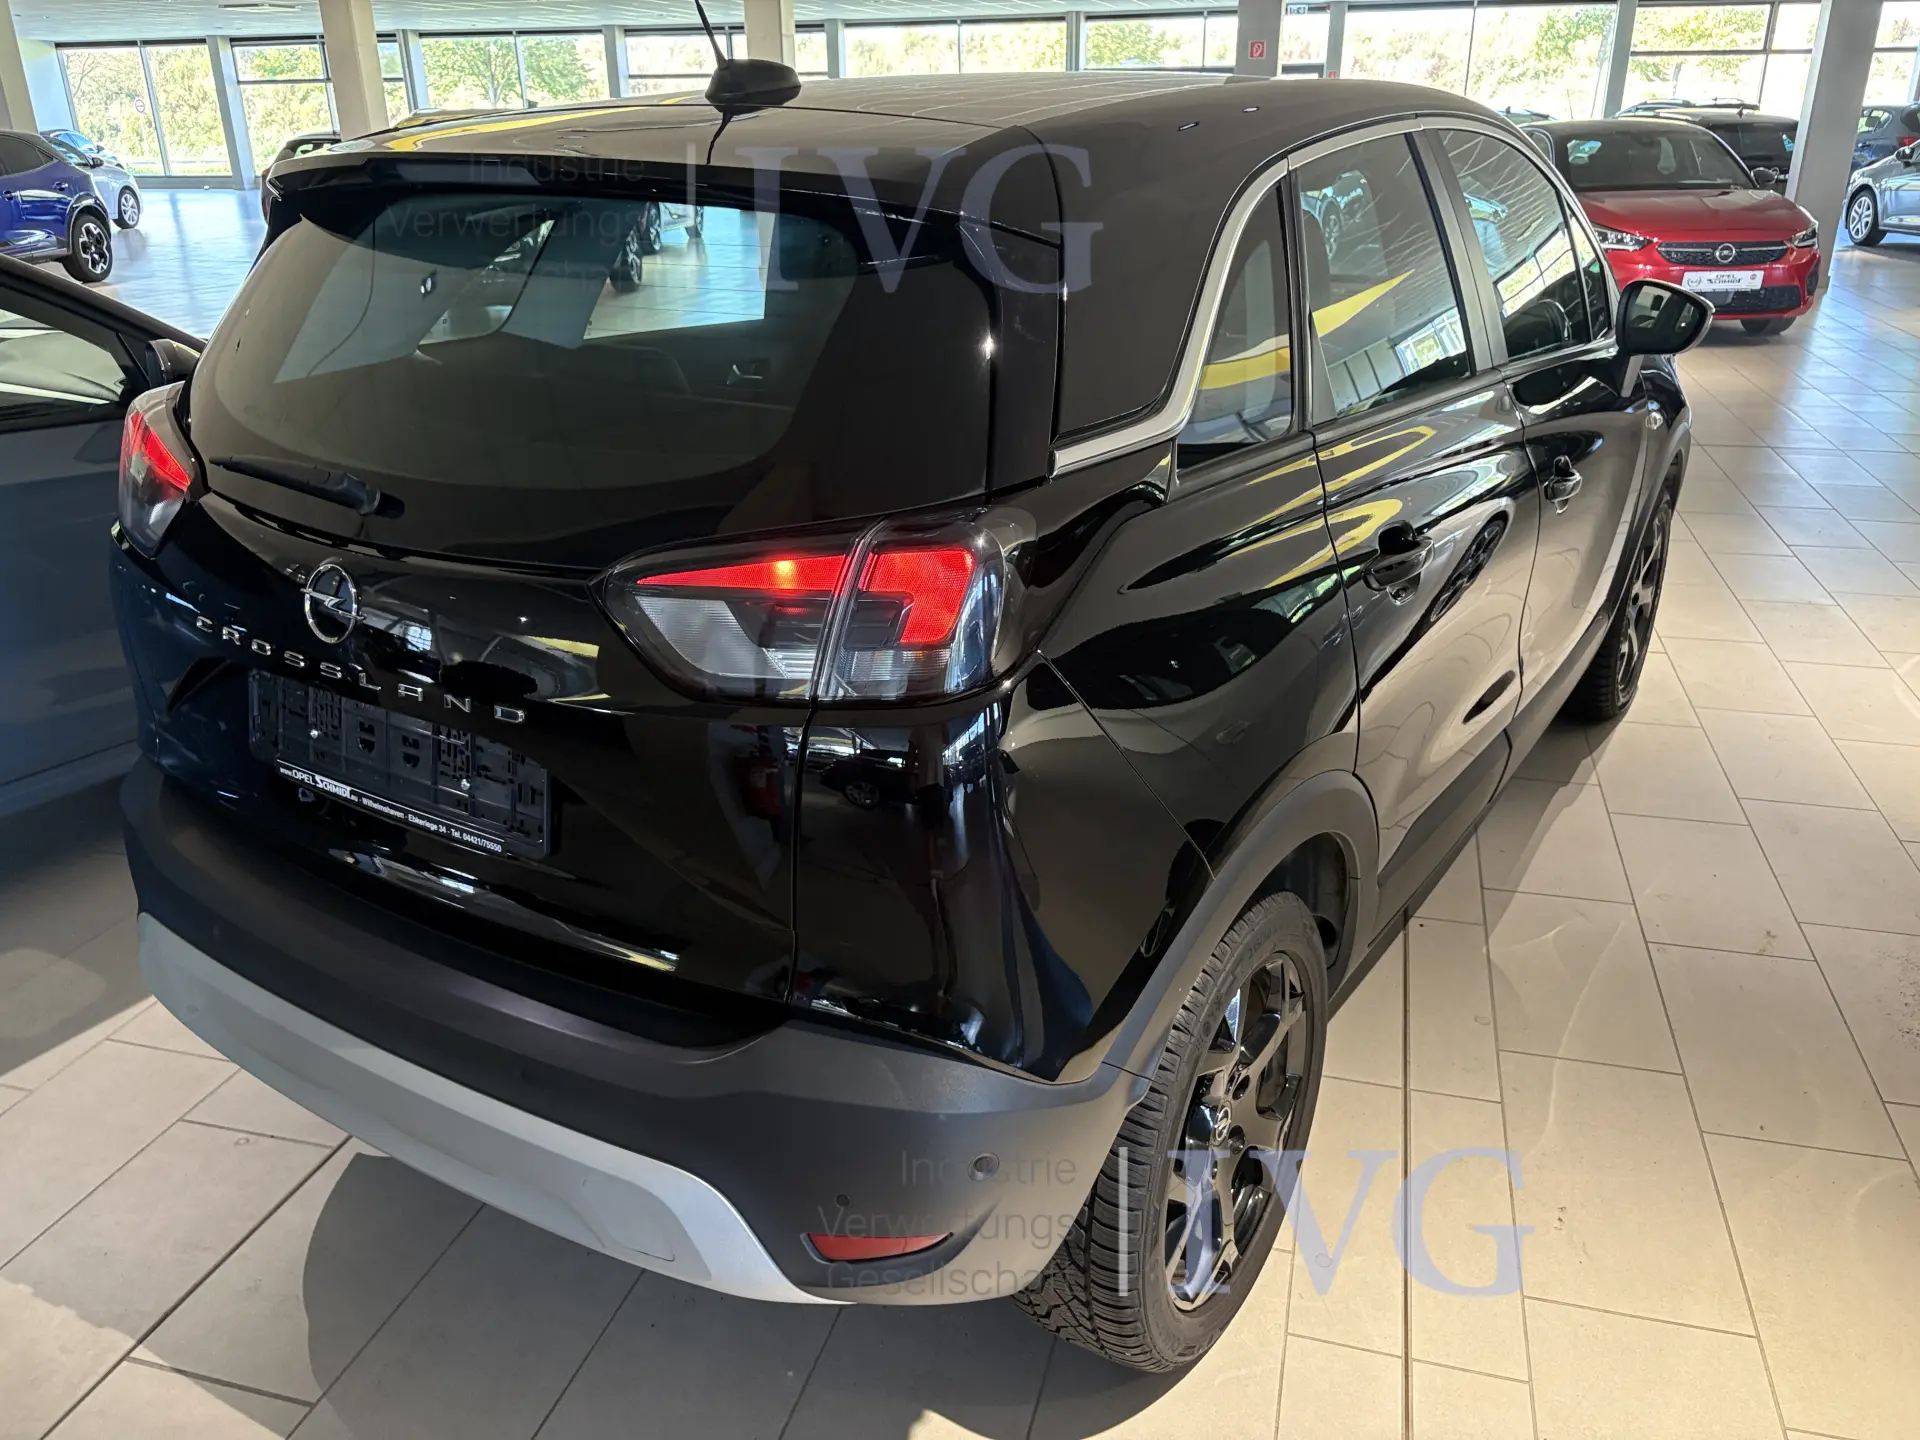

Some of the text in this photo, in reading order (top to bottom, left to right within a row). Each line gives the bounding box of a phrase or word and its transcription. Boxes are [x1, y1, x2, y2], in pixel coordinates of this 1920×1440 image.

[196, 615, 525, 724] CROSSLAND
[362, 797, 405, 819] Wilhelmshaven
[438, 824, 447, 833] 34
[451, 828, 462, 839] Tel.
[463, 832, 502, 853] 04421/75550
